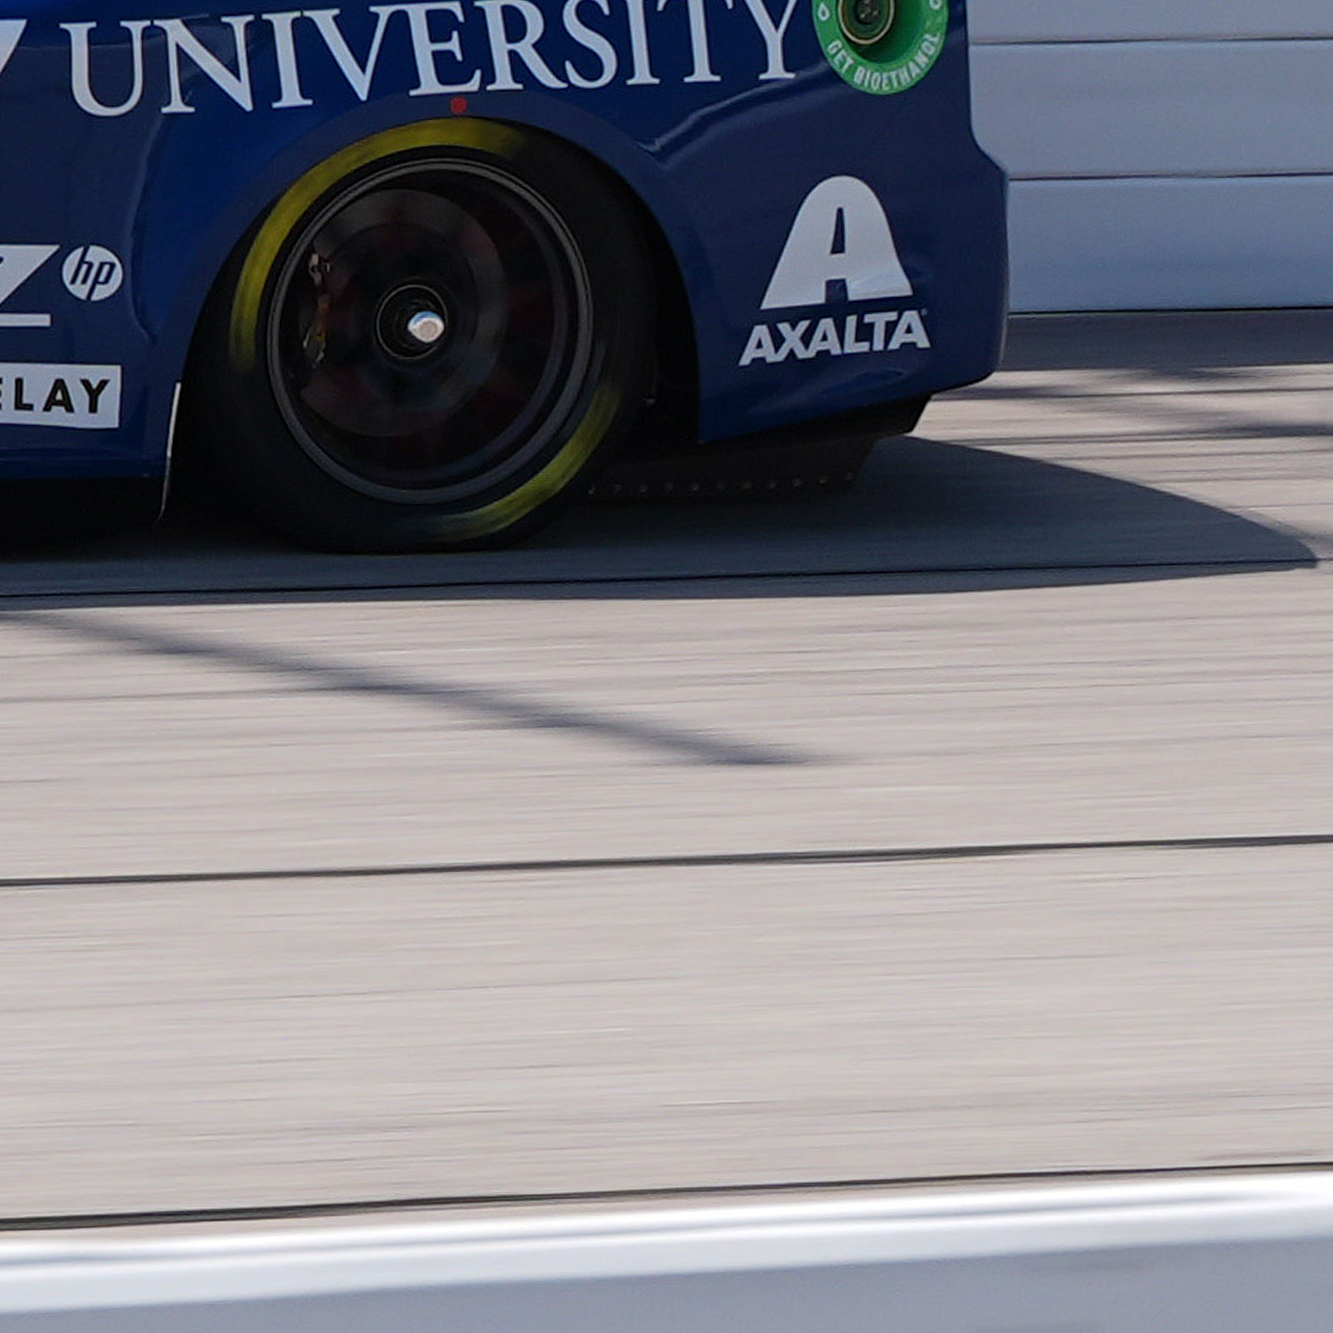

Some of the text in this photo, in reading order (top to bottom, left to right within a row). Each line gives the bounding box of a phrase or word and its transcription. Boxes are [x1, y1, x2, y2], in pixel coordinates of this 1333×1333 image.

[827, 32, 941, 92] GET BIOETHANOL
[66, 245, 121, 302] hp
[738, 309, 932, 367] AXALTA
